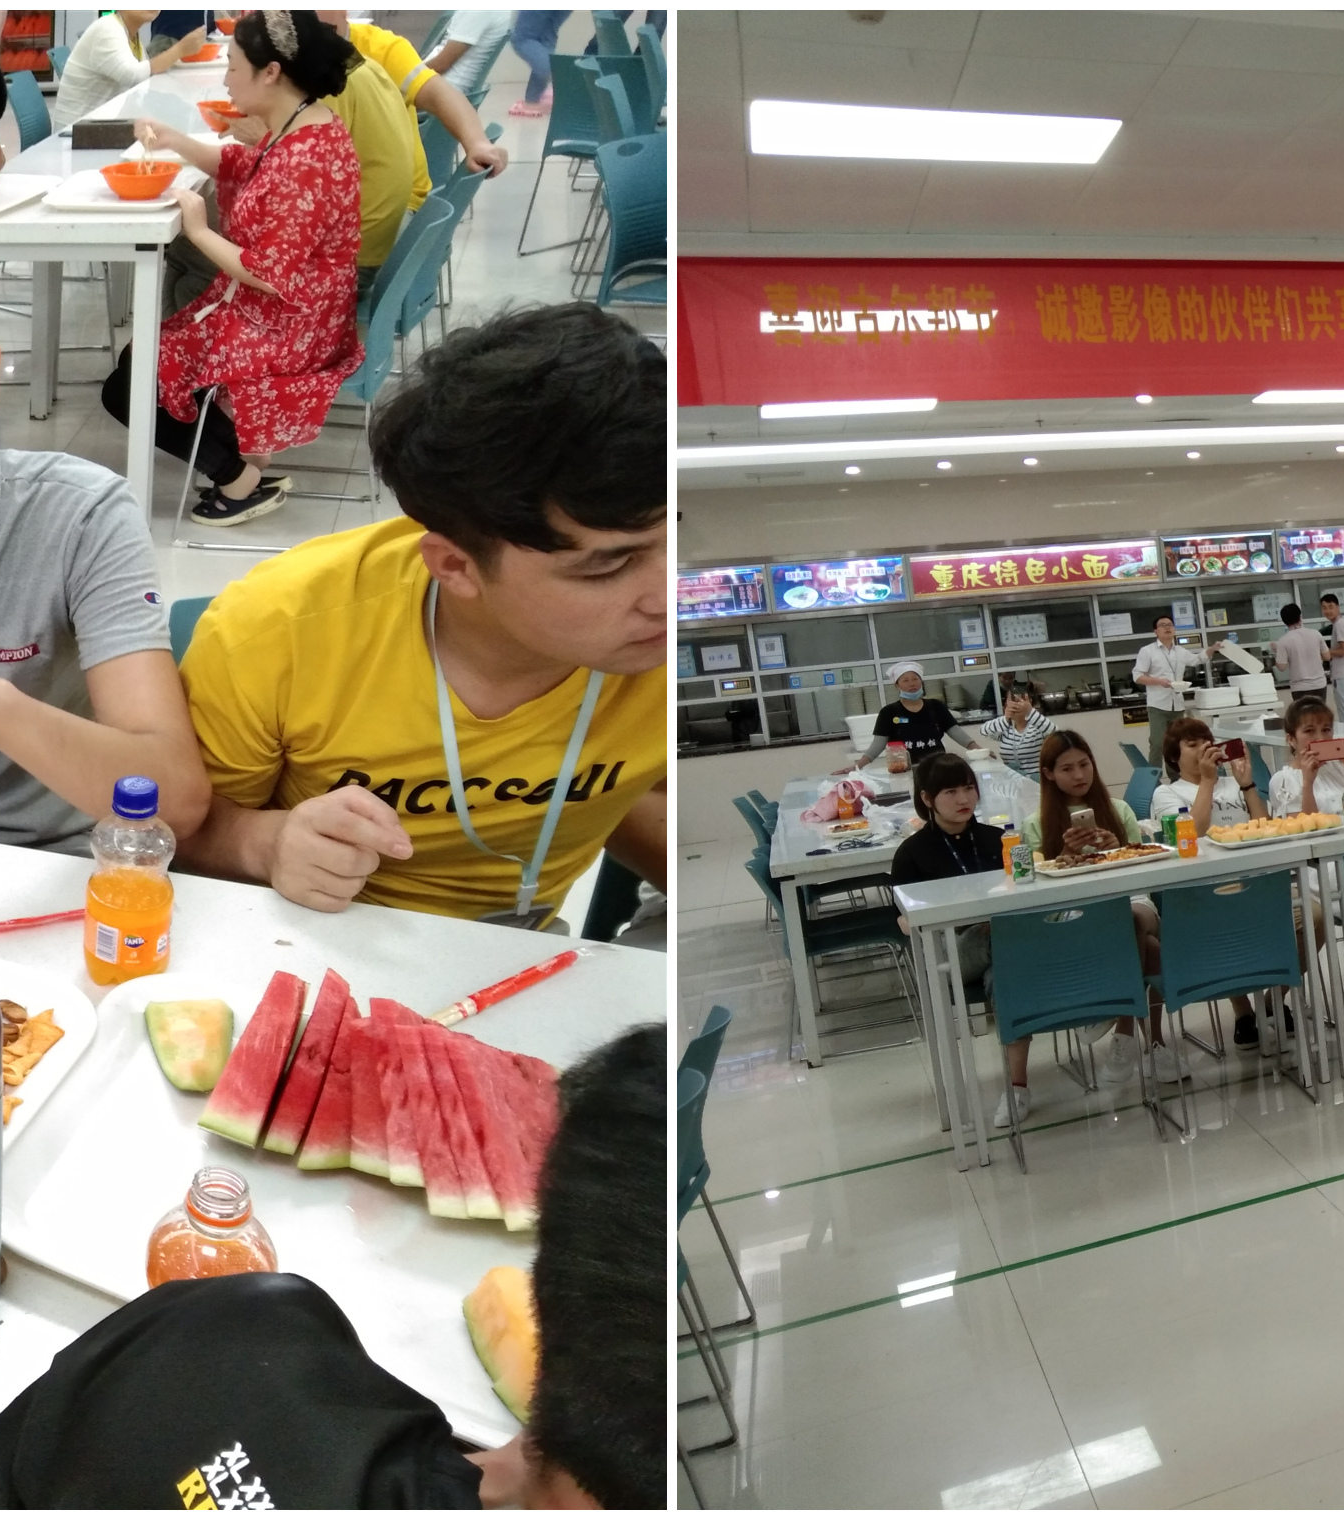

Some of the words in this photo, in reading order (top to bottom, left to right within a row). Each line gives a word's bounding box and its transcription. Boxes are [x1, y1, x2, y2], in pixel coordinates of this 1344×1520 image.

[929, 554, 1110, 592] 重庆特色小面
